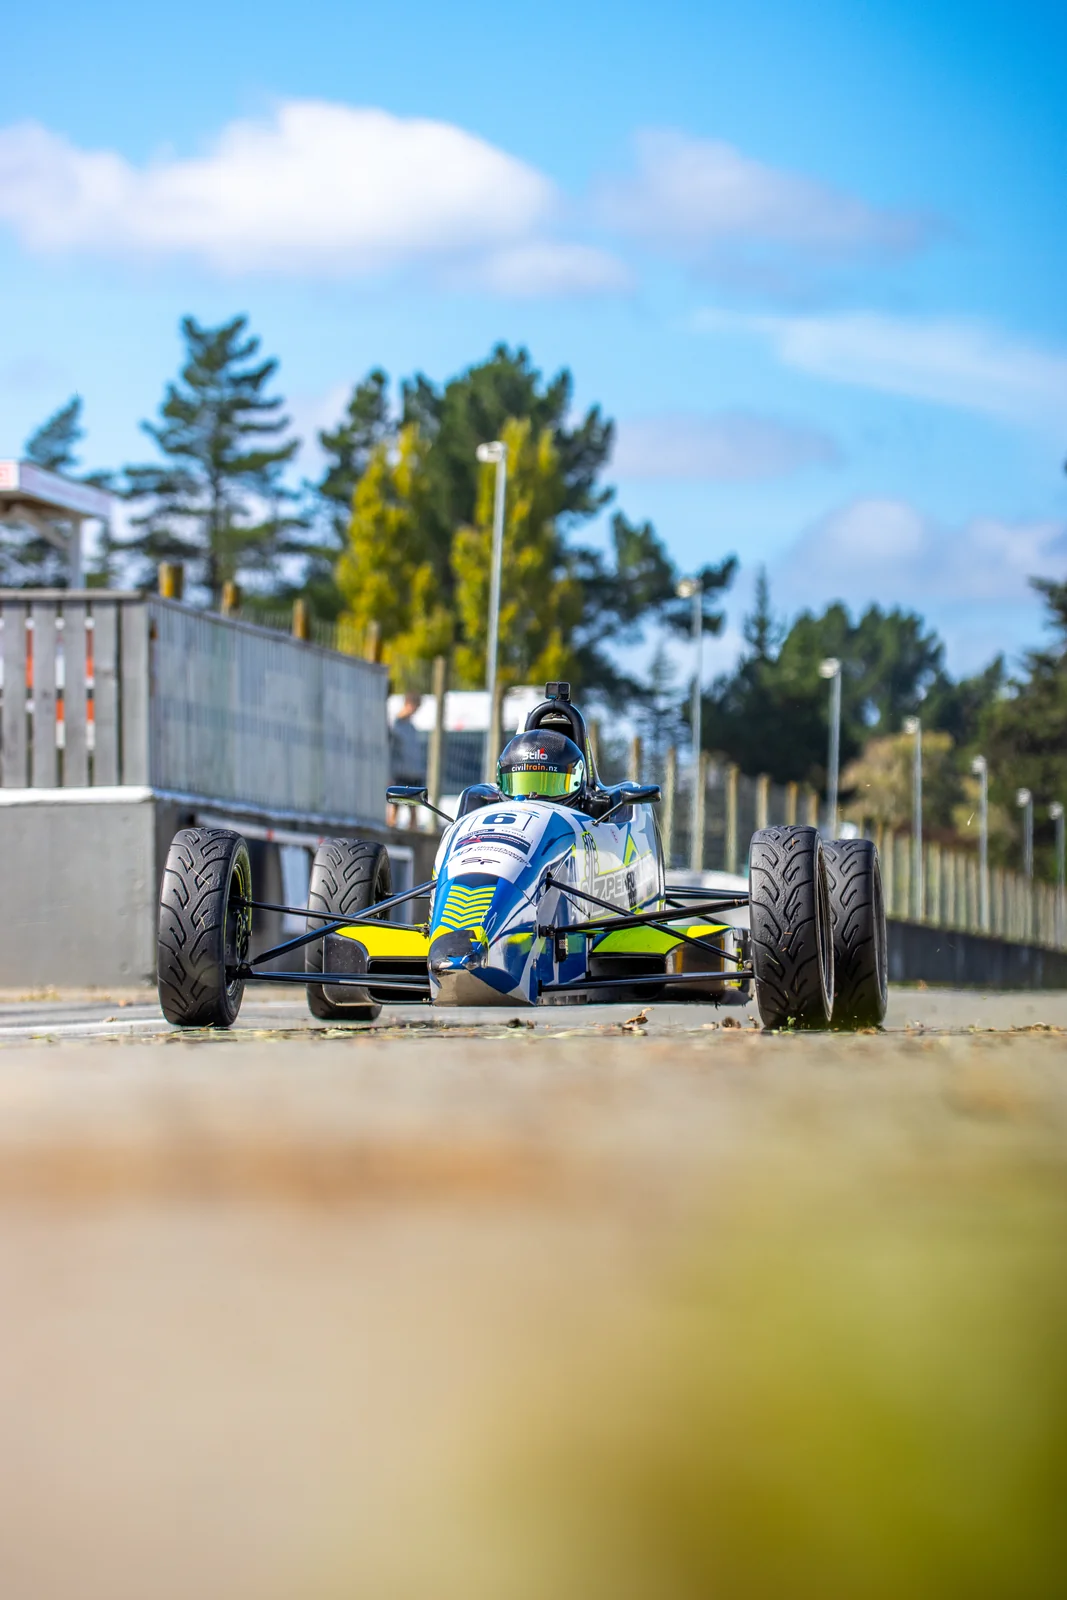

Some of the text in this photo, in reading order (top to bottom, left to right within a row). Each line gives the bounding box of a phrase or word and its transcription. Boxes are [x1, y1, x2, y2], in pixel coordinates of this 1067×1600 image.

[522, 748, 548, 760] Stilo
[511, 763, 558, 772] civiltrain.nz
[482, 813, 517, 824] 6
